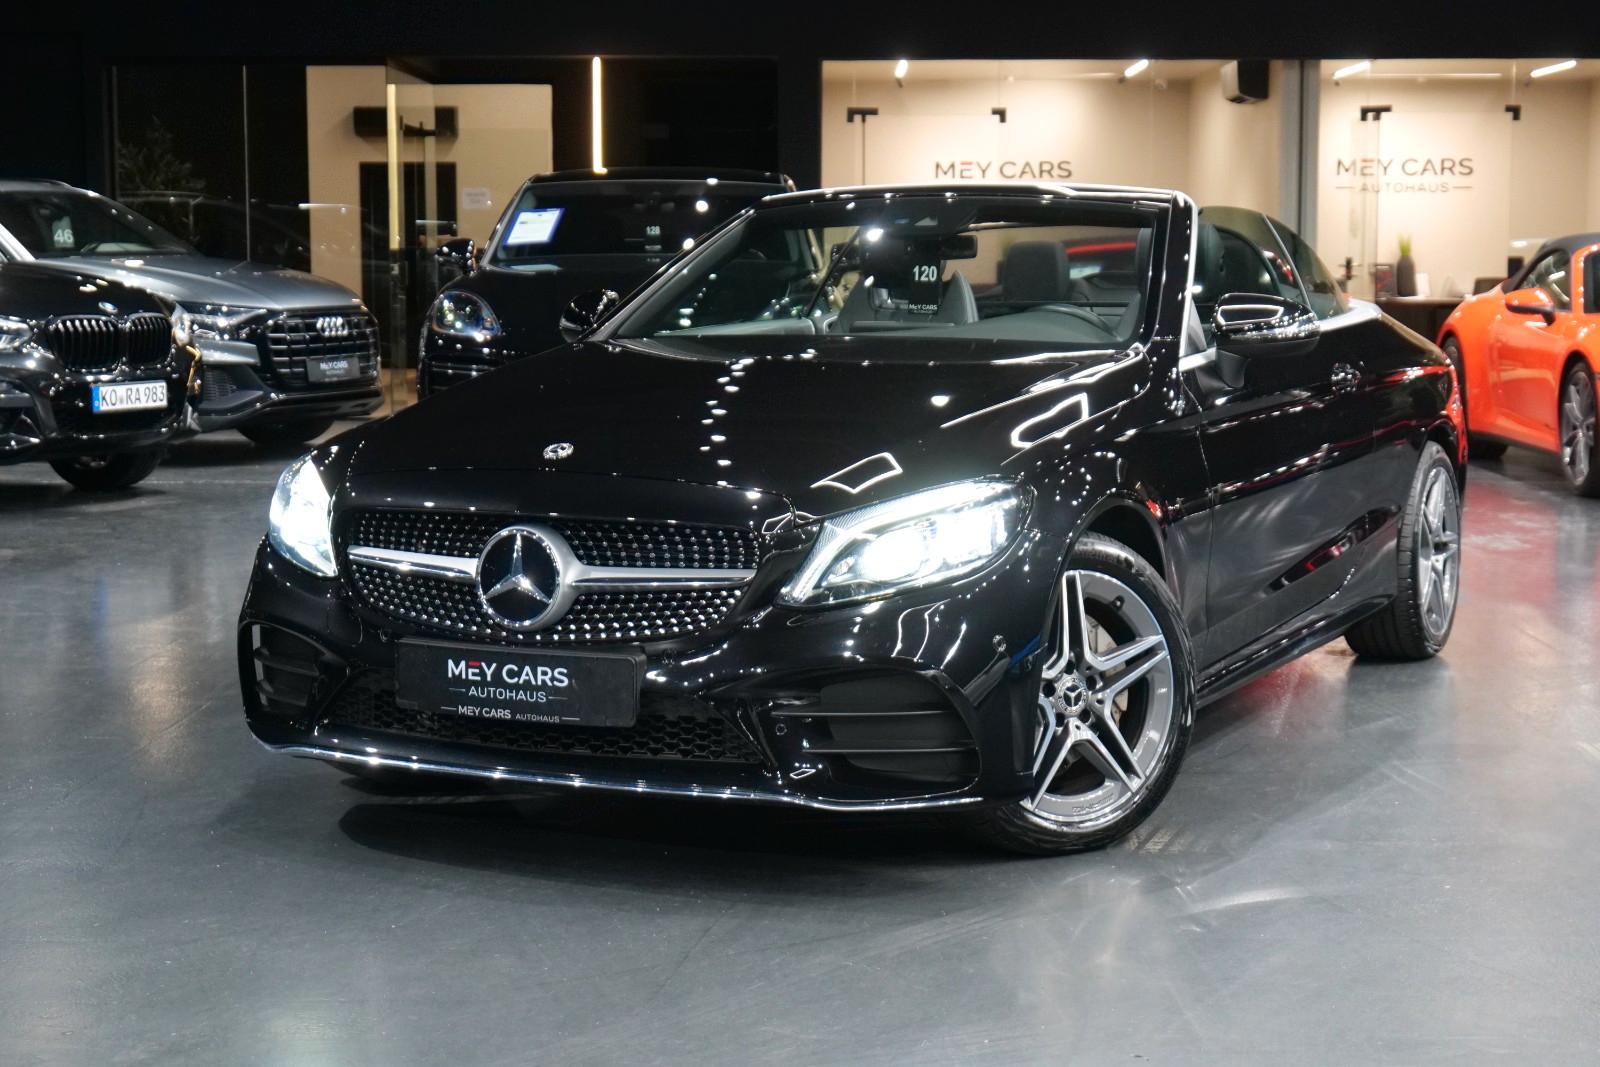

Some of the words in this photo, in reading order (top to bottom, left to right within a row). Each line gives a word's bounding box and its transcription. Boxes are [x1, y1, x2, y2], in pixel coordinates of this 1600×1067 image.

[935, 161, 992, 179] MEY
[999, 160, 1073, 179] CARS
[1336, 158, 1394, 177] MEY
[1401, 157, 1475, 176] CARS
[1359, 182, 1450, 193] AUTOHAUS
[53, 229, 74, 243] 46
[913, 265, 938, 282] 120
[126, 387, 141, 405] RA
[144, 385, 165, 403] 983
[447, 658, 497, 682] MEY
[501, 663, 569, 687] CARS
[468, 686, 547, 703] AUTOHAUS
[458, 704, 481, 717] MEY
[482, 707, 512, 719] CARS
[515, 712, 560, 723] AUTOHAUS
